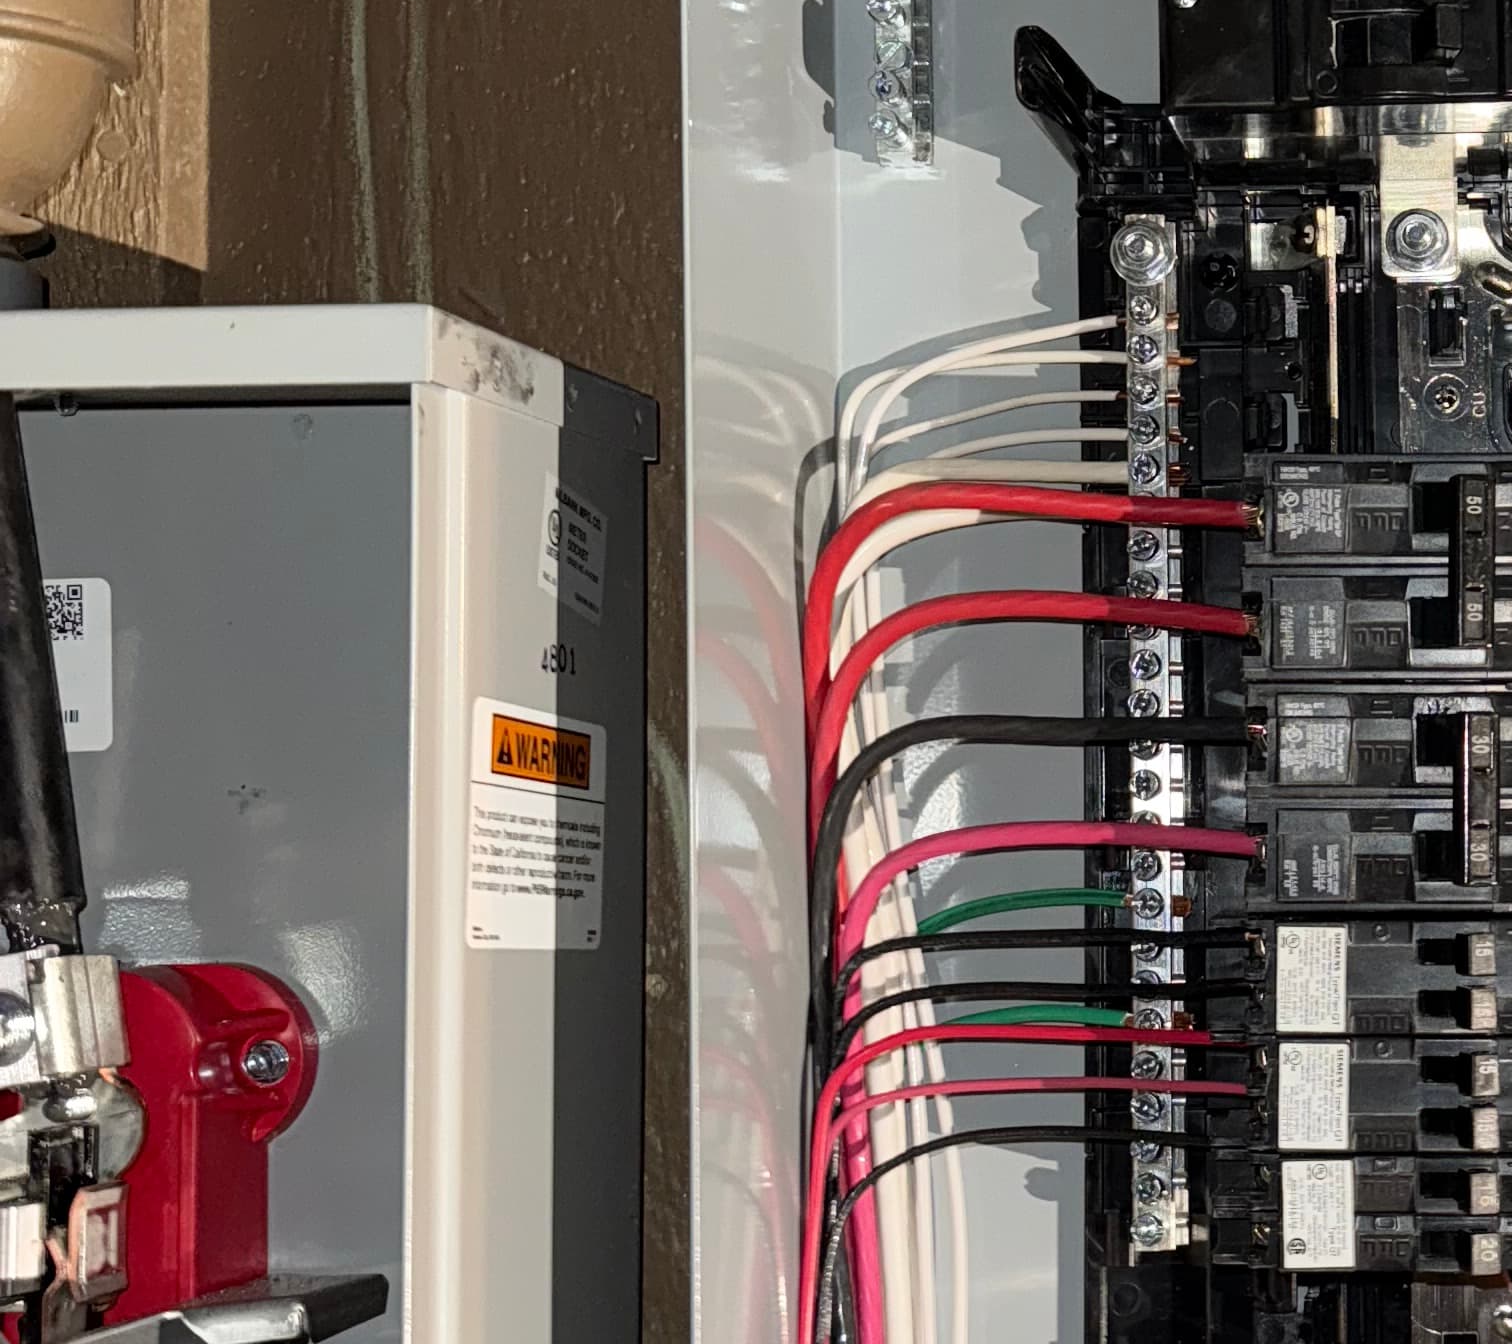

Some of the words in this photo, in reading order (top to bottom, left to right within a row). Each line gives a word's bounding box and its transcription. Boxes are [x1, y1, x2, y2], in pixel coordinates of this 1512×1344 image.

[1464, 496, 1484, 515] 50
[1464, 601, 1484, 623] 50
[1470, 734, 1488, 755] 30
[516, 731, 588, 782] WARNING
[1468, 842, 1486, 862] 30
[1480, 1238, 1498, 1261] 20
